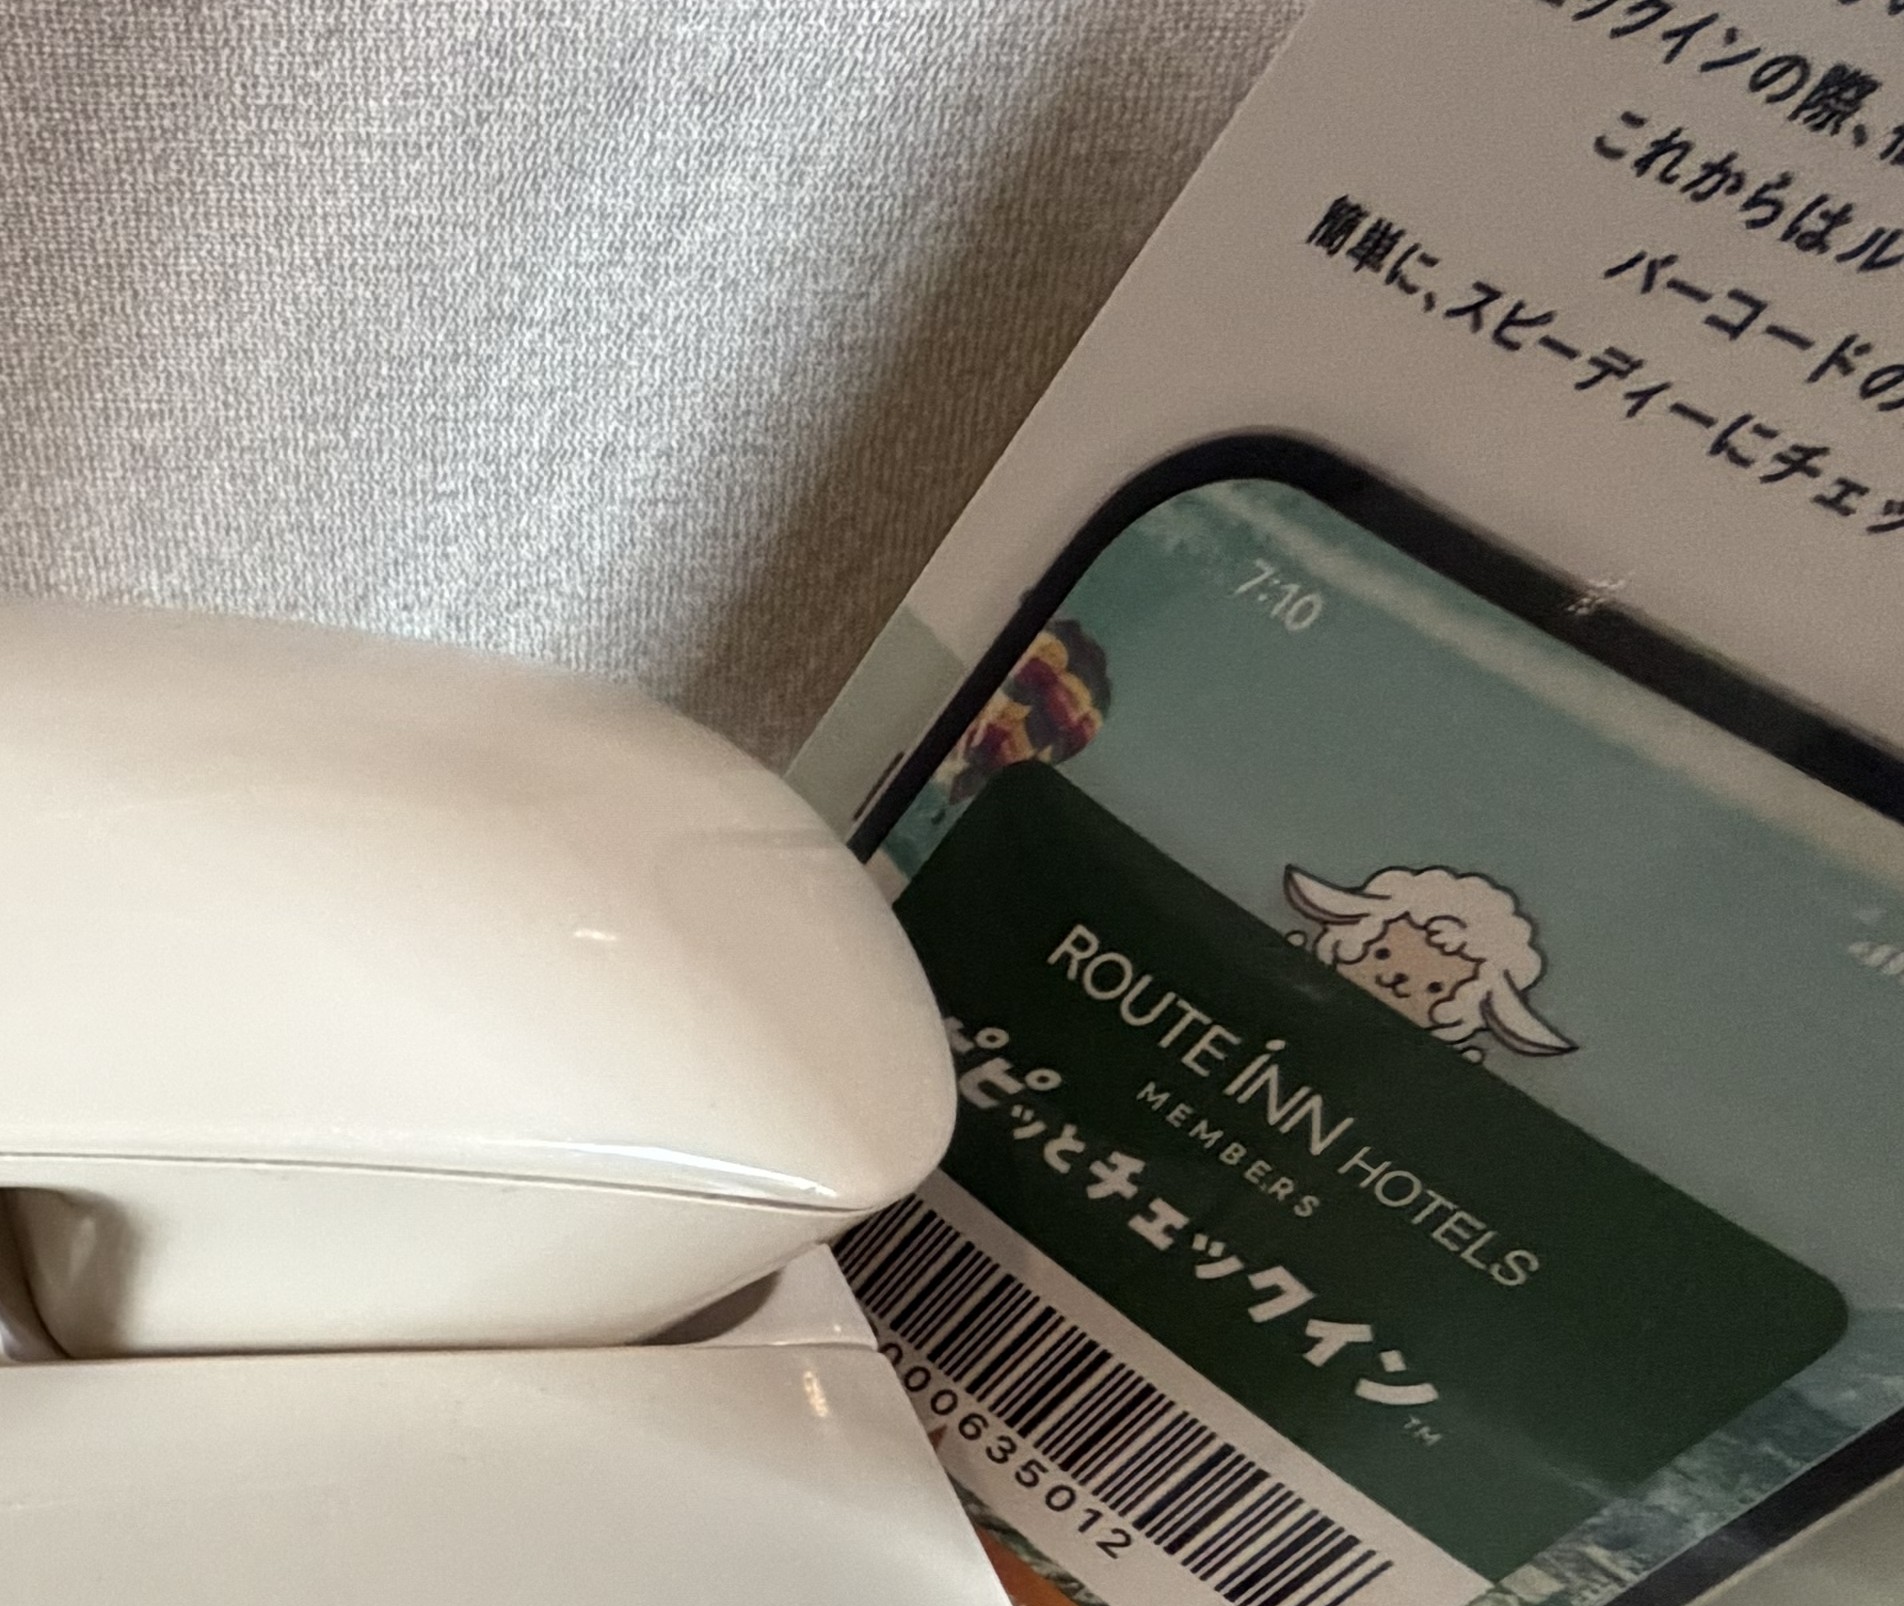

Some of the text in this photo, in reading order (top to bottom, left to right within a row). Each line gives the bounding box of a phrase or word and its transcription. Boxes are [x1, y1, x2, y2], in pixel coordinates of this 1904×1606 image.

[1231, 559, 1323, 635] 7:10
[1048, 924, 1242, 1078] ROUTE
[1338, 1143, 1541, 1290] HOTELS
[1136, 1081, 1320, 1222] MEMBERS
